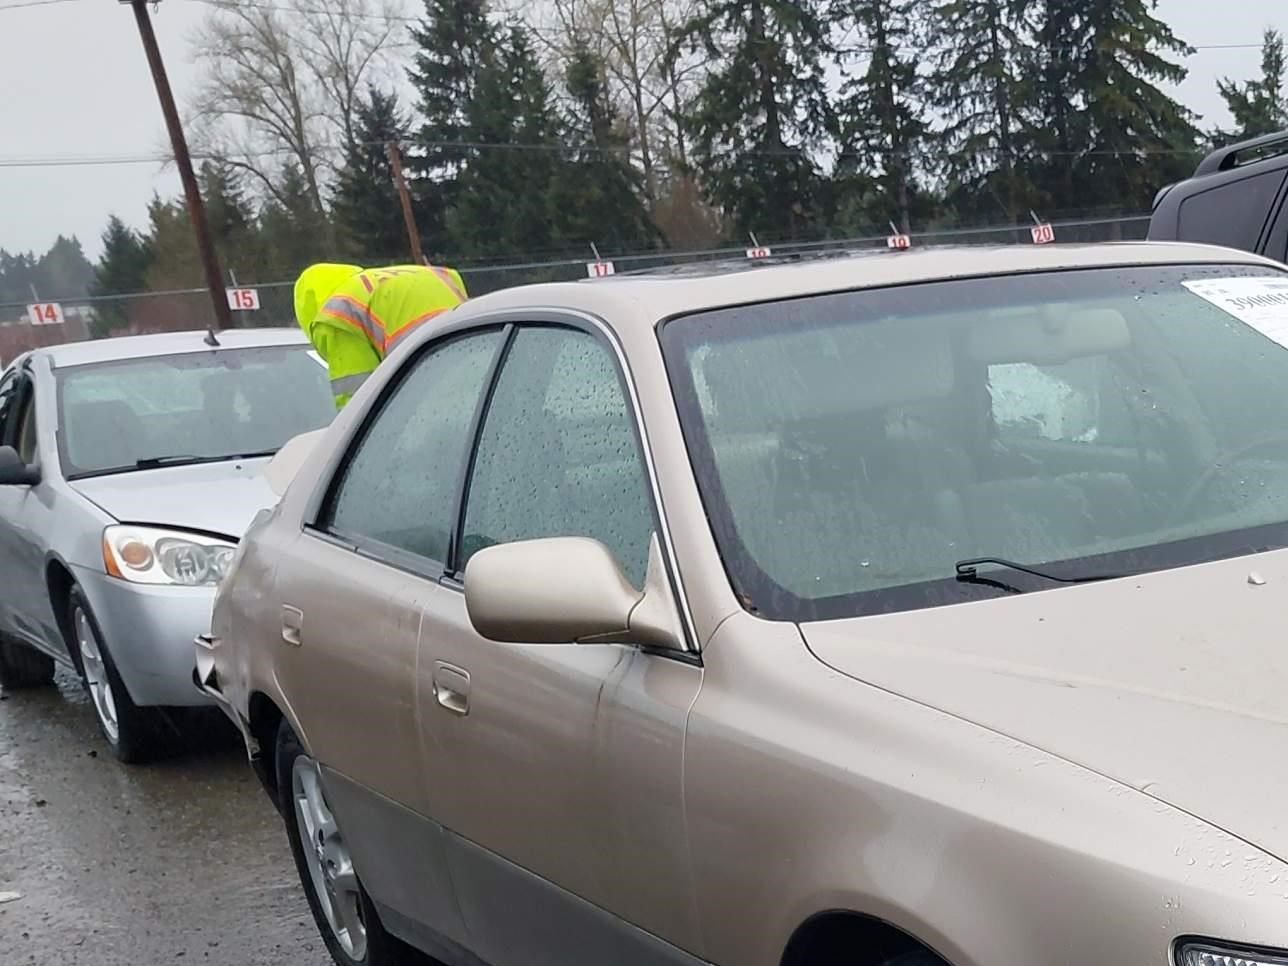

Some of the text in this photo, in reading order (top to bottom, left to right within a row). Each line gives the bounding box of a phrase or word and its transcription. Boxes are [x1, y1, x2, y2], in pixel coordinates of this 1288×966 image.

[1034, 226, 1051, 243] 20
[594, 263, 608, 276] 17
[233, 290, 254, 308] 15
[34, 303, 57, 322] 14
